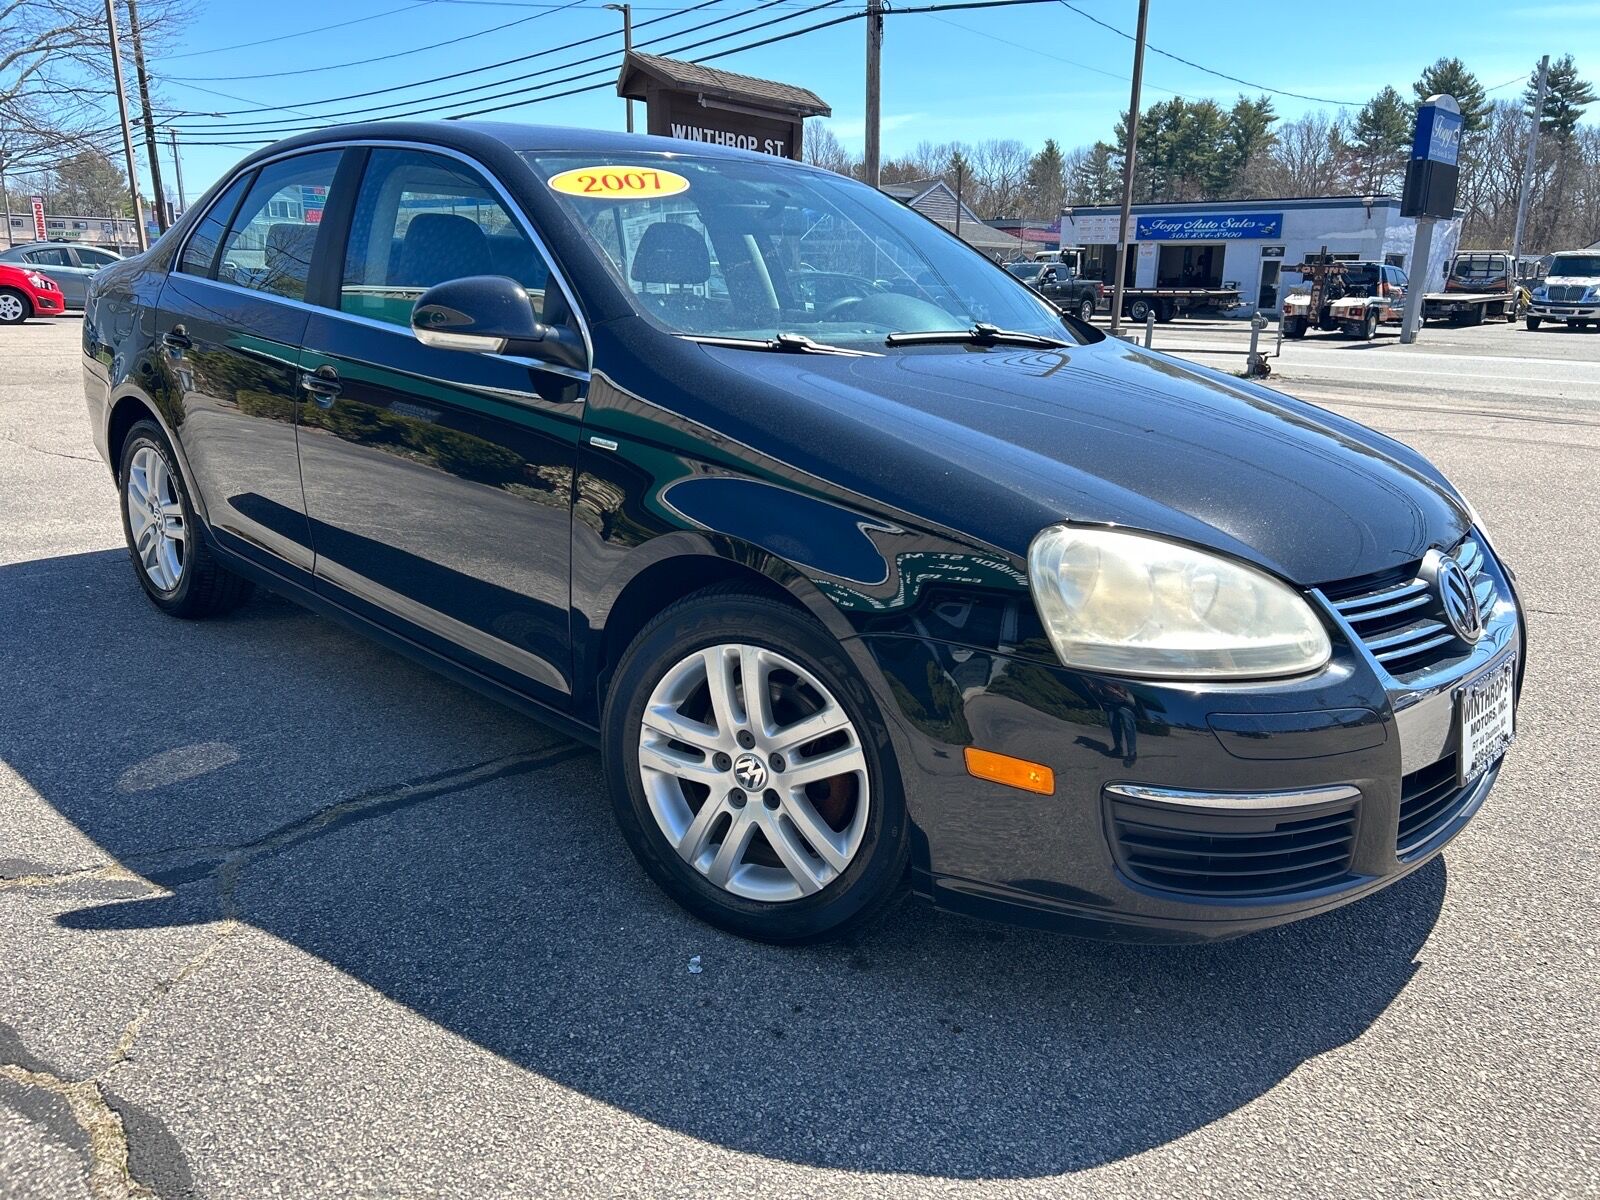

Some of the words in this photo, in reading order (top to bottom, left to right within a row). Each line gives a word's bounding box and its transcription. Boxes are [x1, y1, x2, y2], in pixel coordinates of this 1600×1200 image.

[671, 123, 758, 151] WINTHROP
[577, 172, 661, 193] 2007
[1184, 218, 1219, 229] Auto
[1220, 217, 1256, 229] Sales
[1463, 675, 1504, 725] WINTHROP
